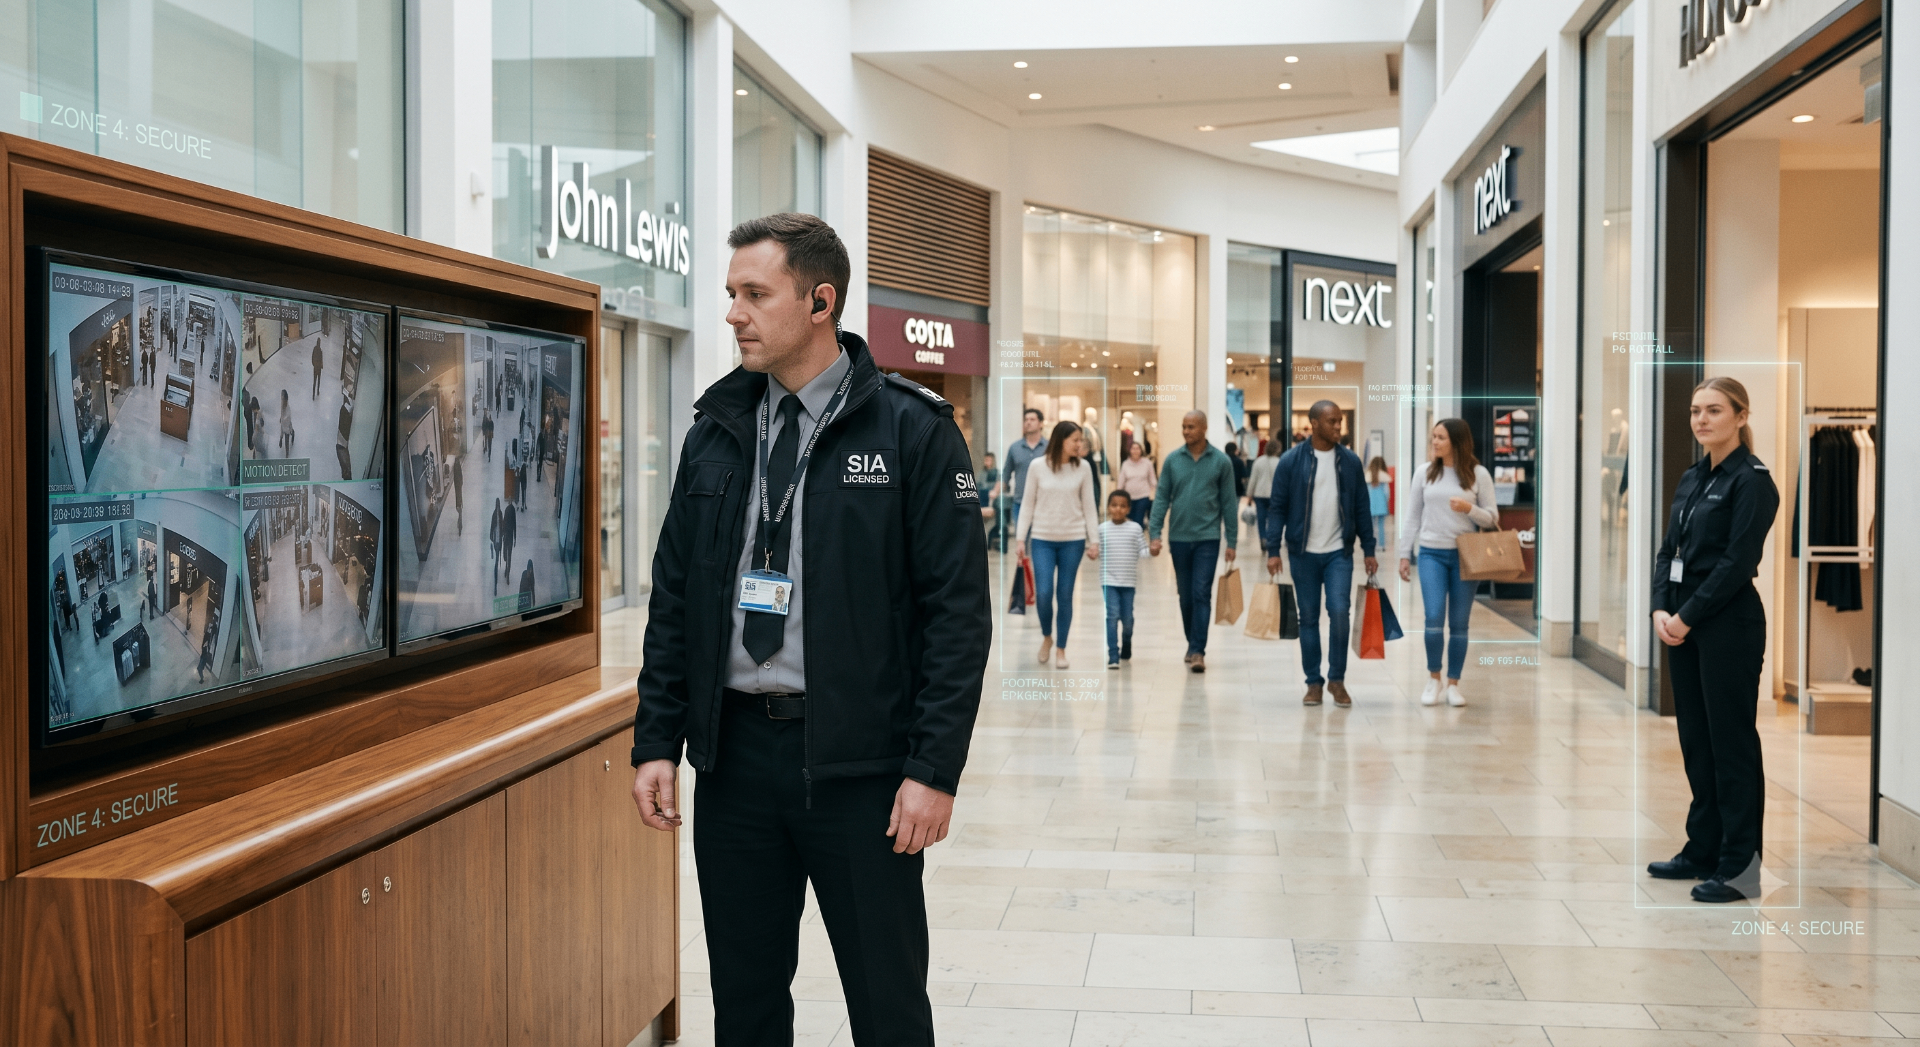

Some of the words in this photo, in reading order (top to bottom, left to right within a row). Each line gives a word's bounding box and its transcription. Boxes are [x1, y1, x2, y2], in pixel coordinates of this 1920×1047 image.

[1473, 143, 1511, 236] next
[545, 144, 619, 260] John
[625, 177, 691, 277] Lewis
[1304, 277, 1392, 328] next
[904, 317, 955, 349] COSTA
[914, 349, 945, 365] COFFEE
[244, 464, 277, 478] MOTION
[278, 463, 308, 477] DETECT
[846, 453, 888, 473] SIA
[843, 474, 890, 484] LICENSED
[955, 472, 977, 490] SIA
